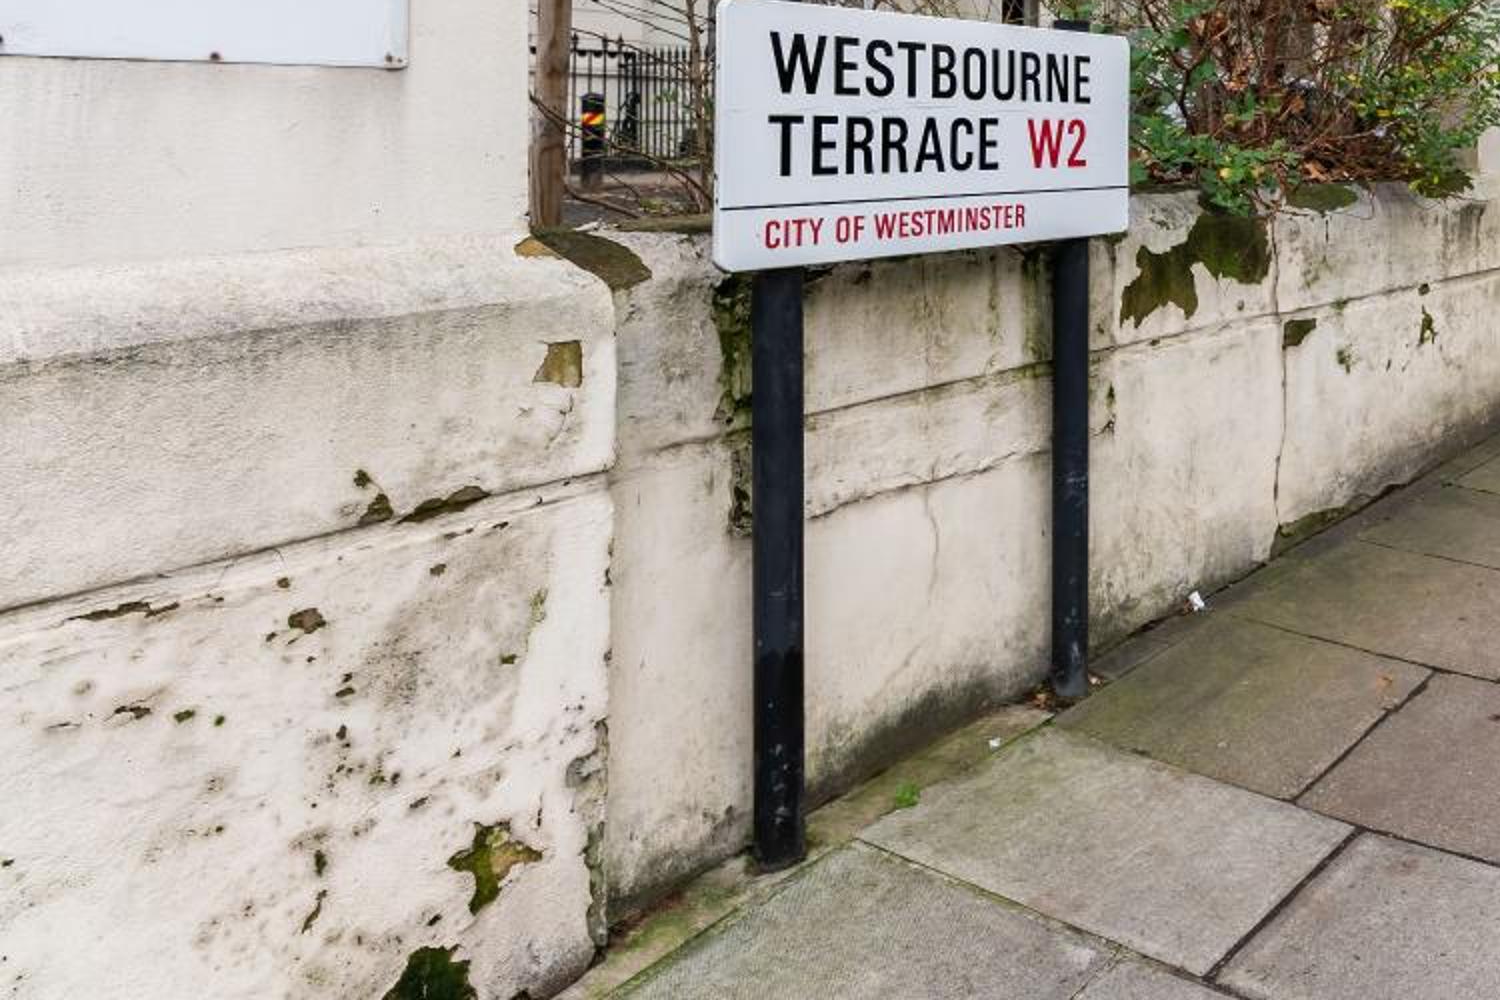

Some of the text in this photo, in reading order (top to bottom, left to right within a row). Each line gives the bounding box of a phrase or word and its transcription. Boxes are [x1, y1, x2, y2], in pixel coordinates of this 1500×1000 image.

[770, 31, 1091, 104] WESTBOURNE
[768, 115, 1086, 176] TERRACE W2
[765, 204, 1025, 249] CITY OF WESTMINSTER
